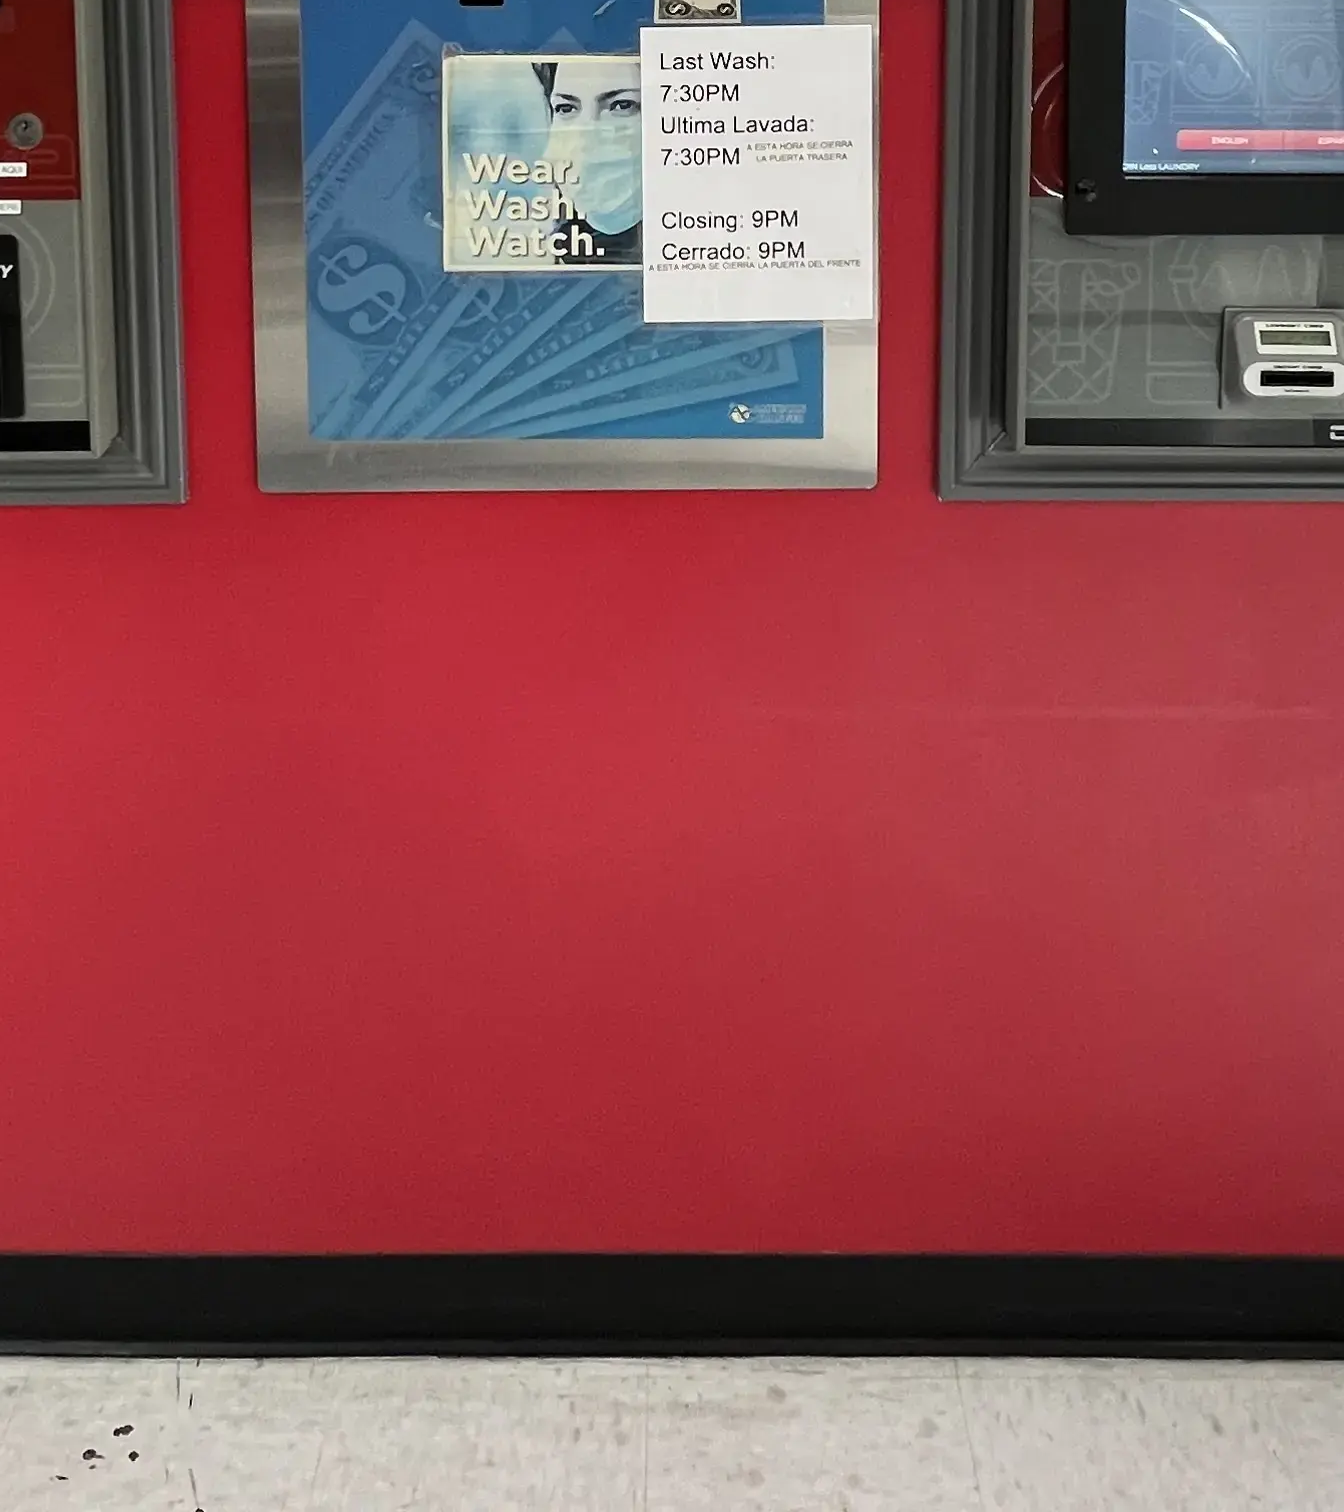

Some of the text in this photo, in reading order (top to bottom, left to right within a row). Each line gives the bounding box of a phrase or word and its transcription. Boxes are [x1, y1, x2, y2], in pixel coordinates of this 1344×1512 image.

[661, 52, 774, 70] Last Wash:
[660, 84, 738, 102] 7:30PM
[662, 115, 814, 134] Ultima Lavada:
[661, 148, 739, 166] 7:30PM
[770, 154, 804, 162] PUERTA
[462, 153, 580, 184] Wear.
[465, 189, 587, 220] Wash.
[662, 210, 798, 232] Closing: 9PM
[468, 226, 606, 257] Watch.
[662, 242, 804, 260] Cerrado: 9PM
